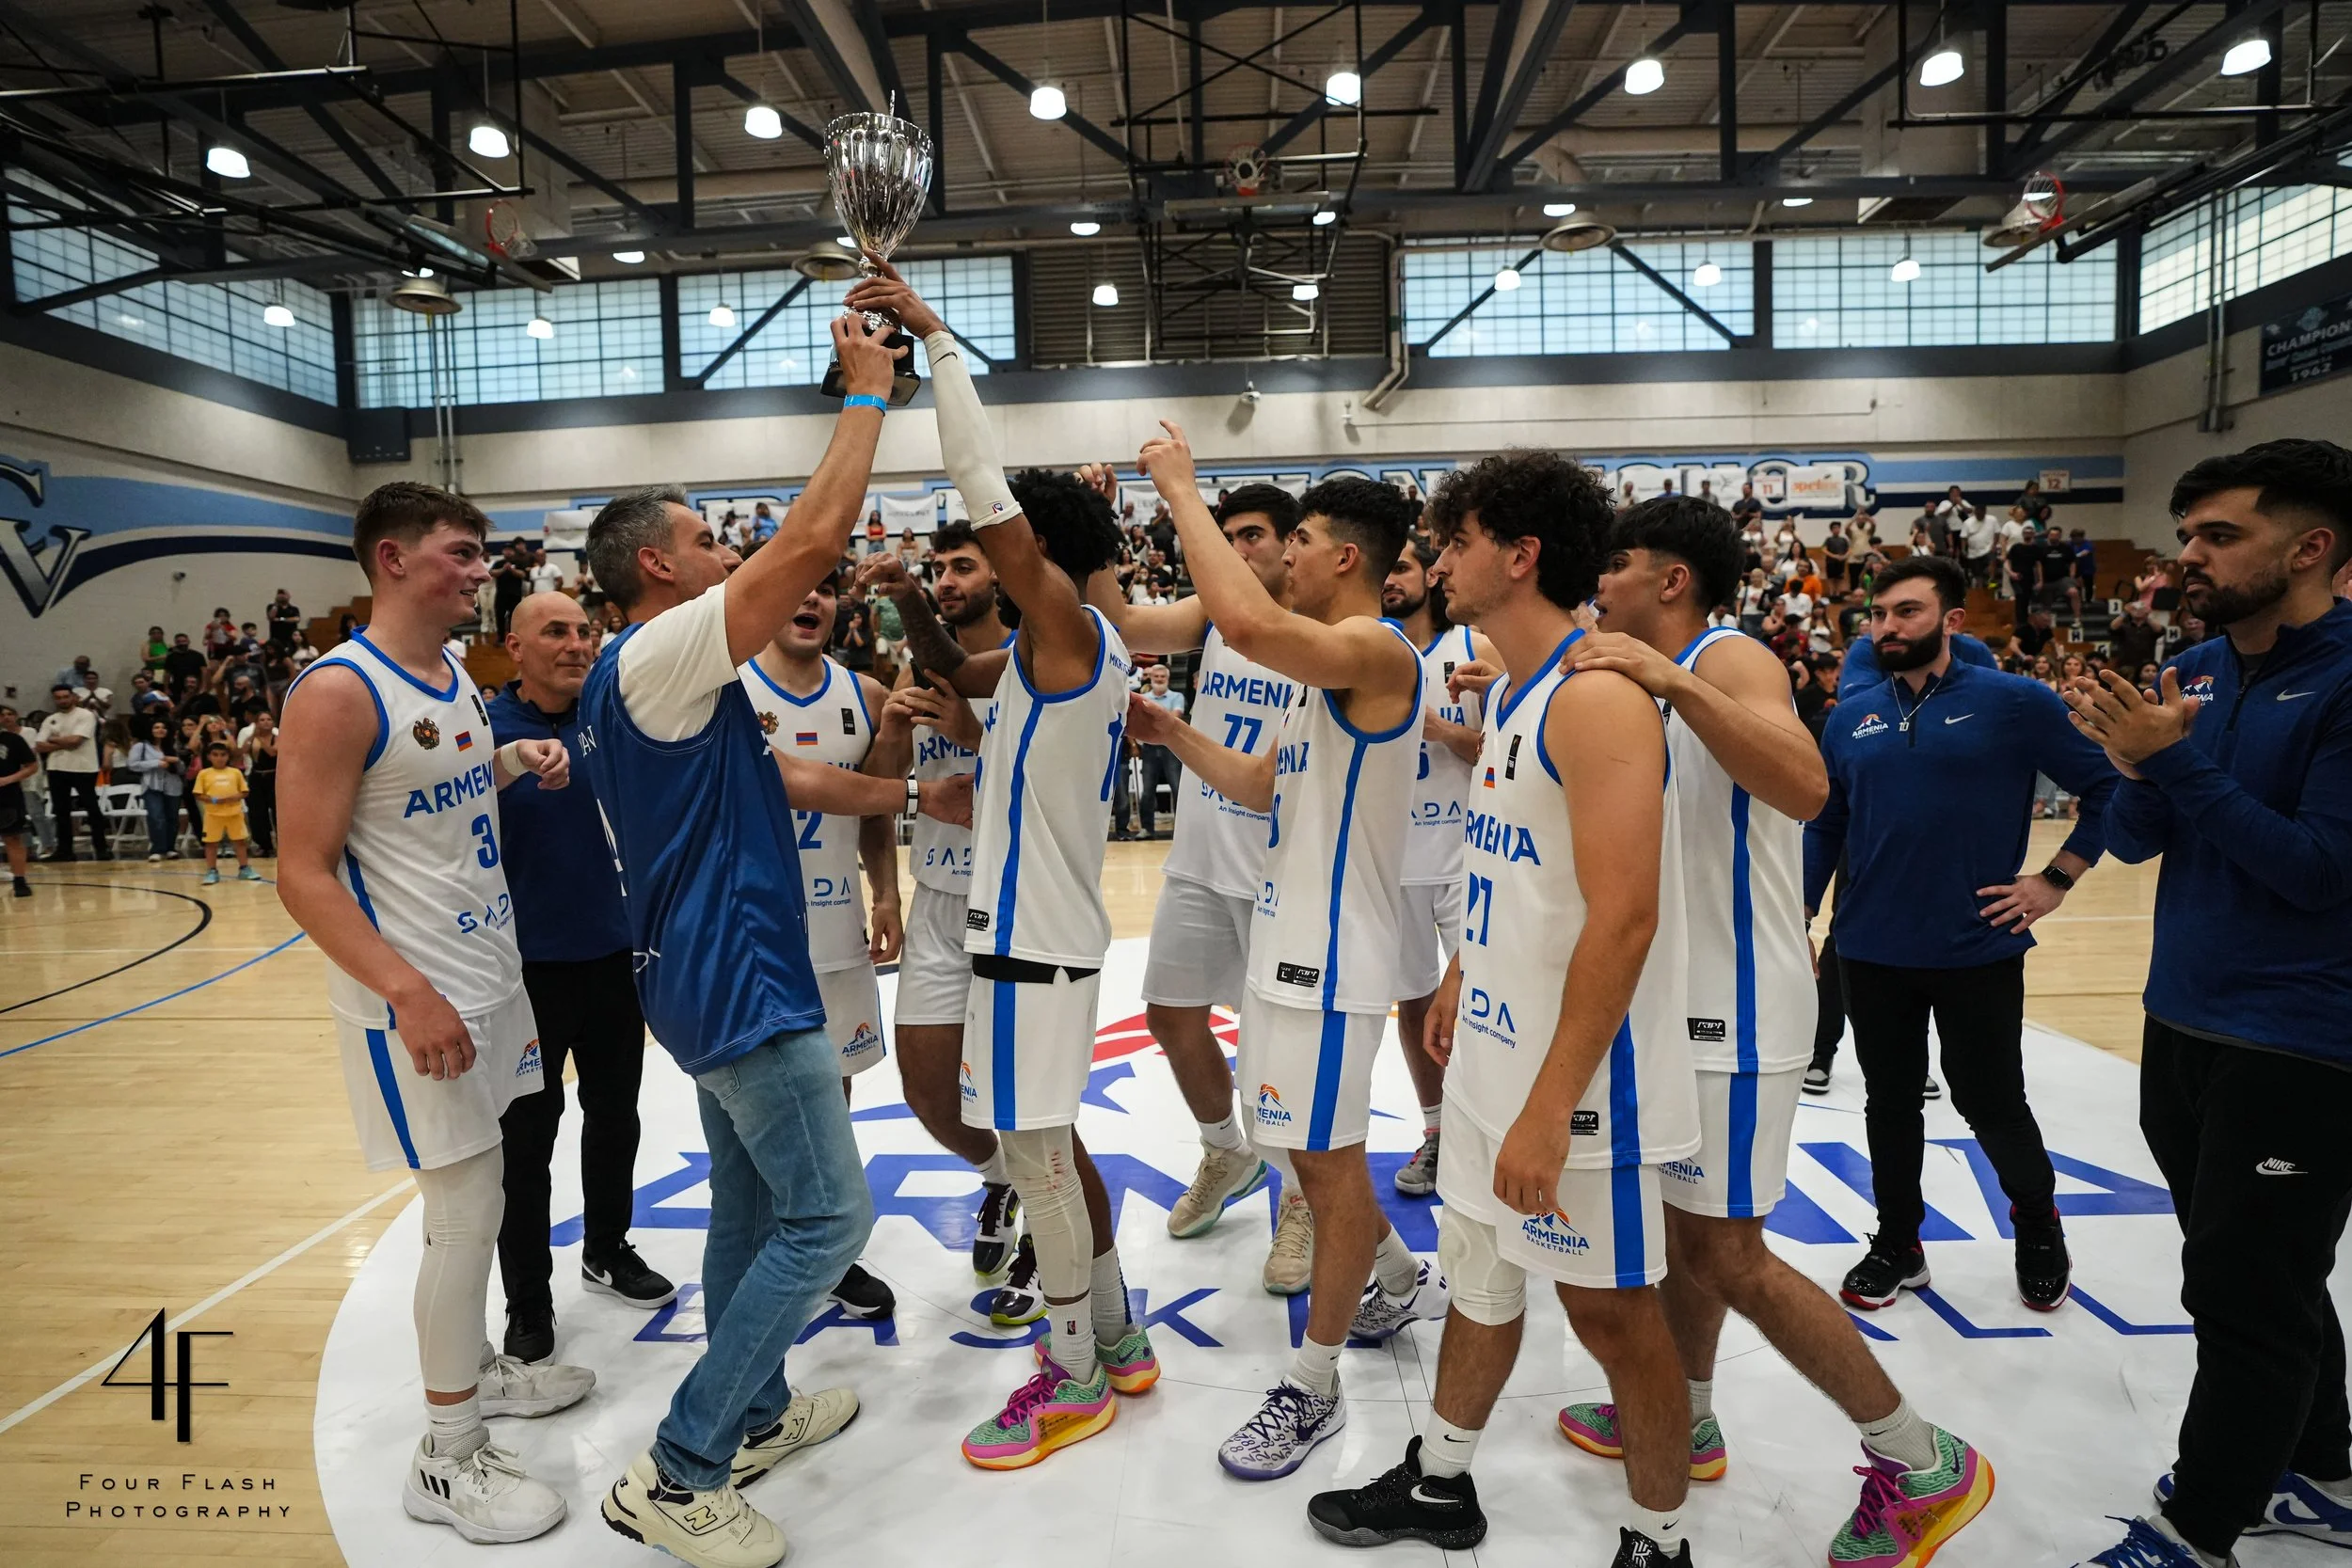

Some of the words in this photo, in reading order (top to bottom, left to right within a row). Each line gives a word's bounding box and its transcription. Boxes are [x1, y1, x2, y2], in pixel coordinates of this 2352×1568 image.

[1224, 713, 1263, 755] 77
[1852, 723, 1889, 737] ARMENIA
[404, 759, 497, 818] ARMEN
[1228, 807, 1246, 817] Insight
[471, 813, 499, 869] 3
[810, 898, 833, 907] Insight
[1462, 988, 1516, 1034] DA
[842, 1035, 879, 1053] ARMENIA
[1469, 1018, 1489, 1035] Insight
[1489, 1029, 1517, 1050] company
[1573, 1114, 1597, 1122] apt
[1661, 1162, 1705, 1178] MENIA
[2264, 1157, 2296, 1172] NIKE
[1522, 1220, 1590, 1249] ARMENIA
[1526, 1234, 1583, 1257] BASKETBALL
[683, 1505, 719, 1531] N
